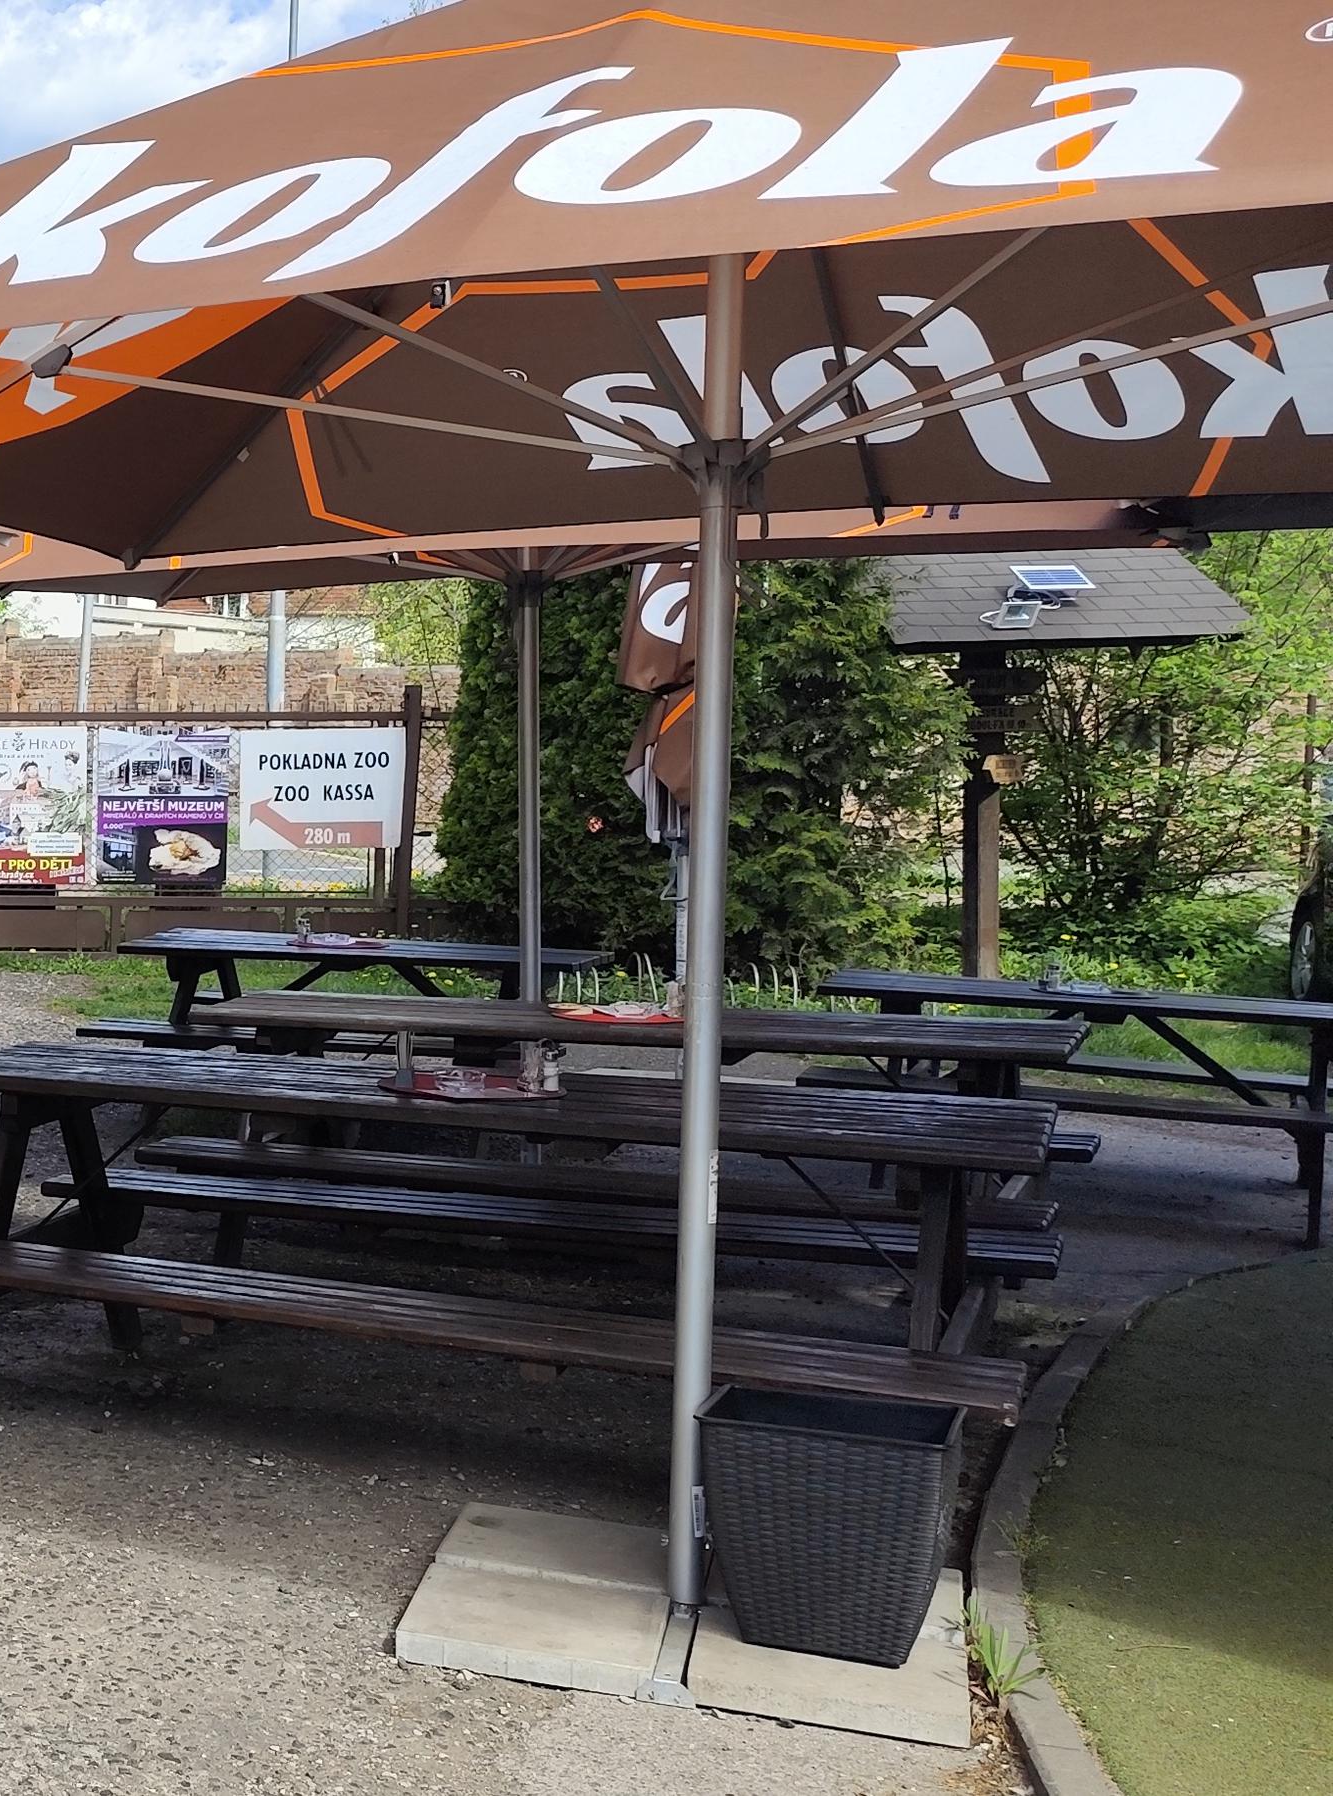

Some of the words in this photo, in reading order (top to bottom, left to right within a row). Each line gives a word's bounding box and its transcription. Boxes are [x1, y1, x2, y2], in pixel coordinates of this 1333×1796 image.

[259, 753, 347, 770] POKLADNA
[354, 751, 390, 768] ZOO
[274, 786, 310, 802] ZOO
[323, 784, 374, 800] KASSA
[102, 799, 165, 812] NEJVĚTŠÍ
[168, 801, 225, 812] MUZEUM
[304, 828, 334, 844] 280
[337, 831, 351, 844] m
[8, 859, 36, 871] PRO
